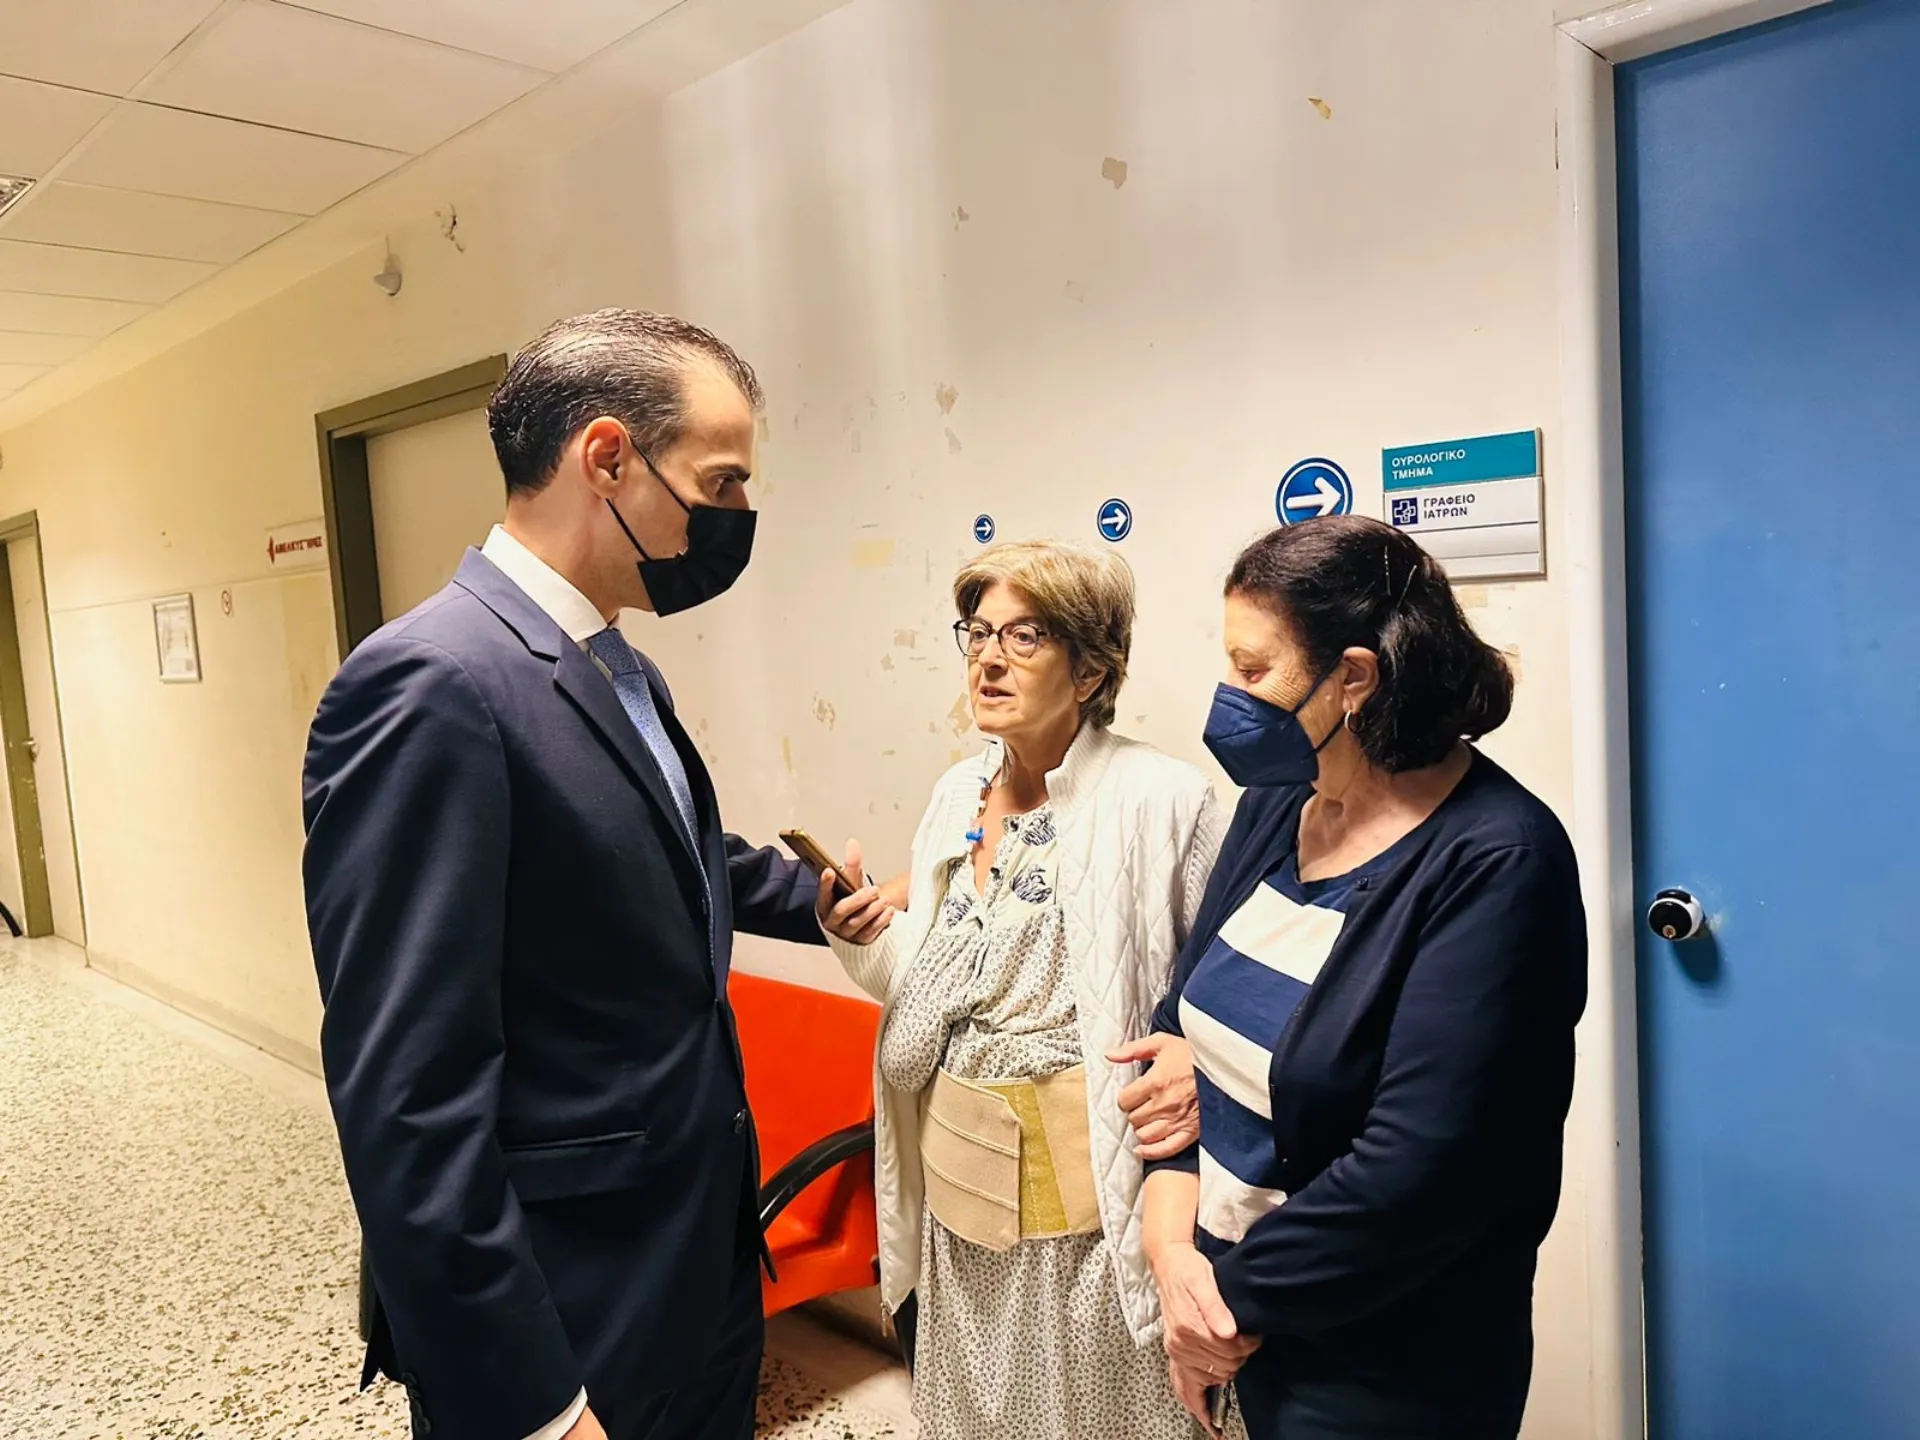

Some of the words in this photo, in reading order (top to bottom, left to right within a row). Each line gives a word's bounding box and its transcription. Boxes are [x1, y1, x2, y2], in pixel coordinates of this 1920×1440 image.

[1391, 449, 1466, 467] ΟΥΡΟΛΟΓΙΚΟ
[1391, 467, 1434, 480] ΤΜΗΜΑ
[1423, 493, 1476, 508] ΓΡΑΦΕΙΟ
[1423, 507, 1468, 519] ΙΑΤΡΩΝ
